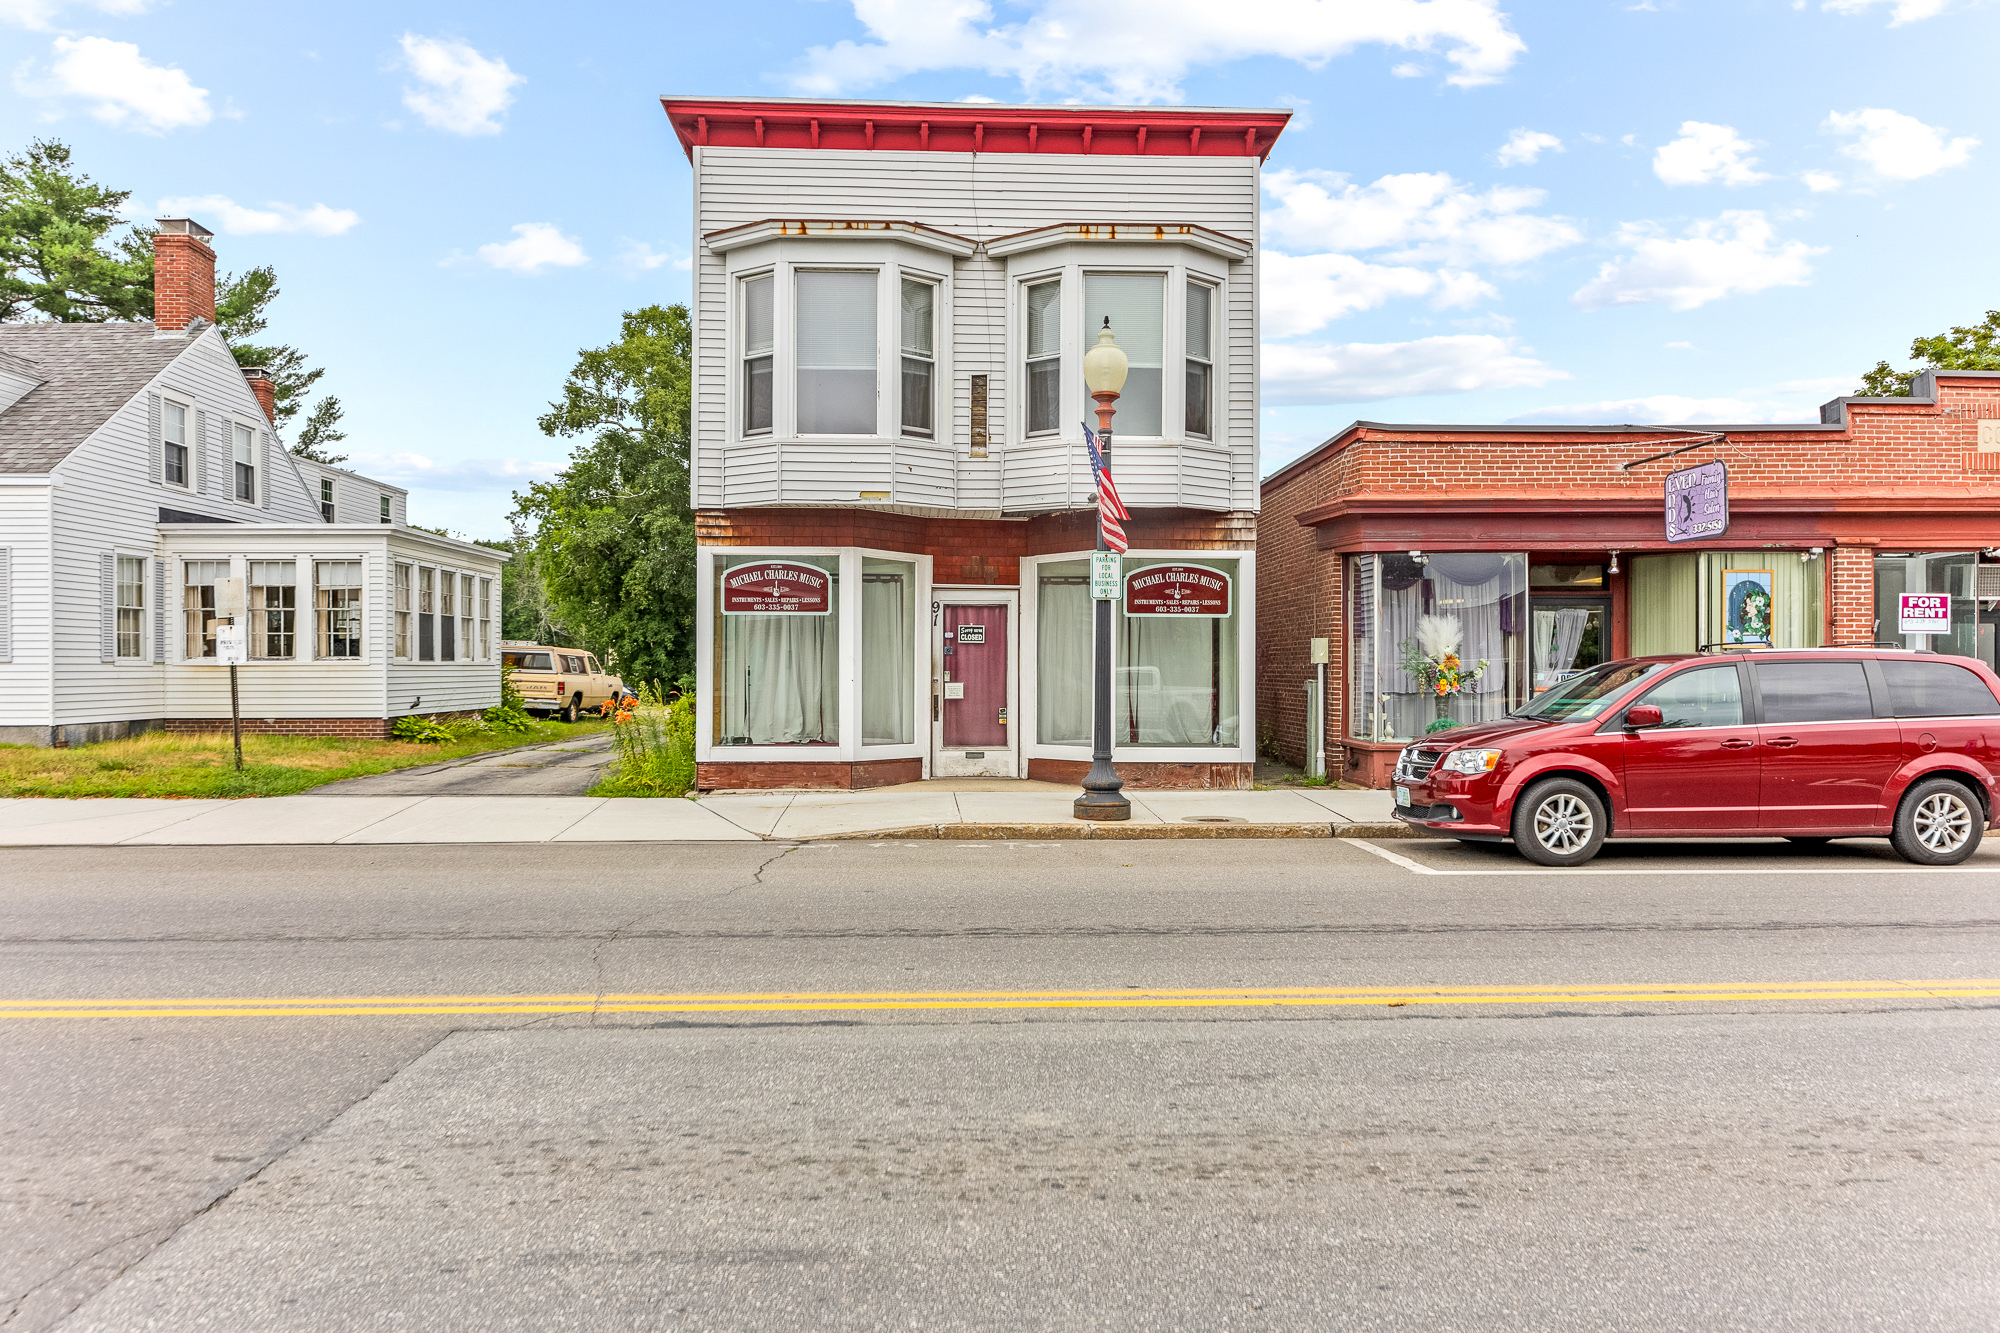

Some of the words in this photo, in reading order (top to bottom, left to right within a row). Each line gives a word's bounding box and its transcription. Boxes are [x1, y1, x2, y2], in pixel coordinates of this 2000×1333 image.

[1701, 470, 1722, 487] Family
[1704, 487, 1719, 500] Hair
[1703, 501, 1720, 515] Salon
[729, 571, 763, 588] MICHAEL
[764, 569, 799, 581] CHARLES
[799, 572, 824, 589] MUSIC
[1132, 573, 1165, 591] MICHAEL
[1166, 572, 1199, 584] CHARLES
[1199, 575, 1224, 591] MUSIC
[1908, 597, 1941, 608] FOR
[1903, 607, 1946, 618] RENT
